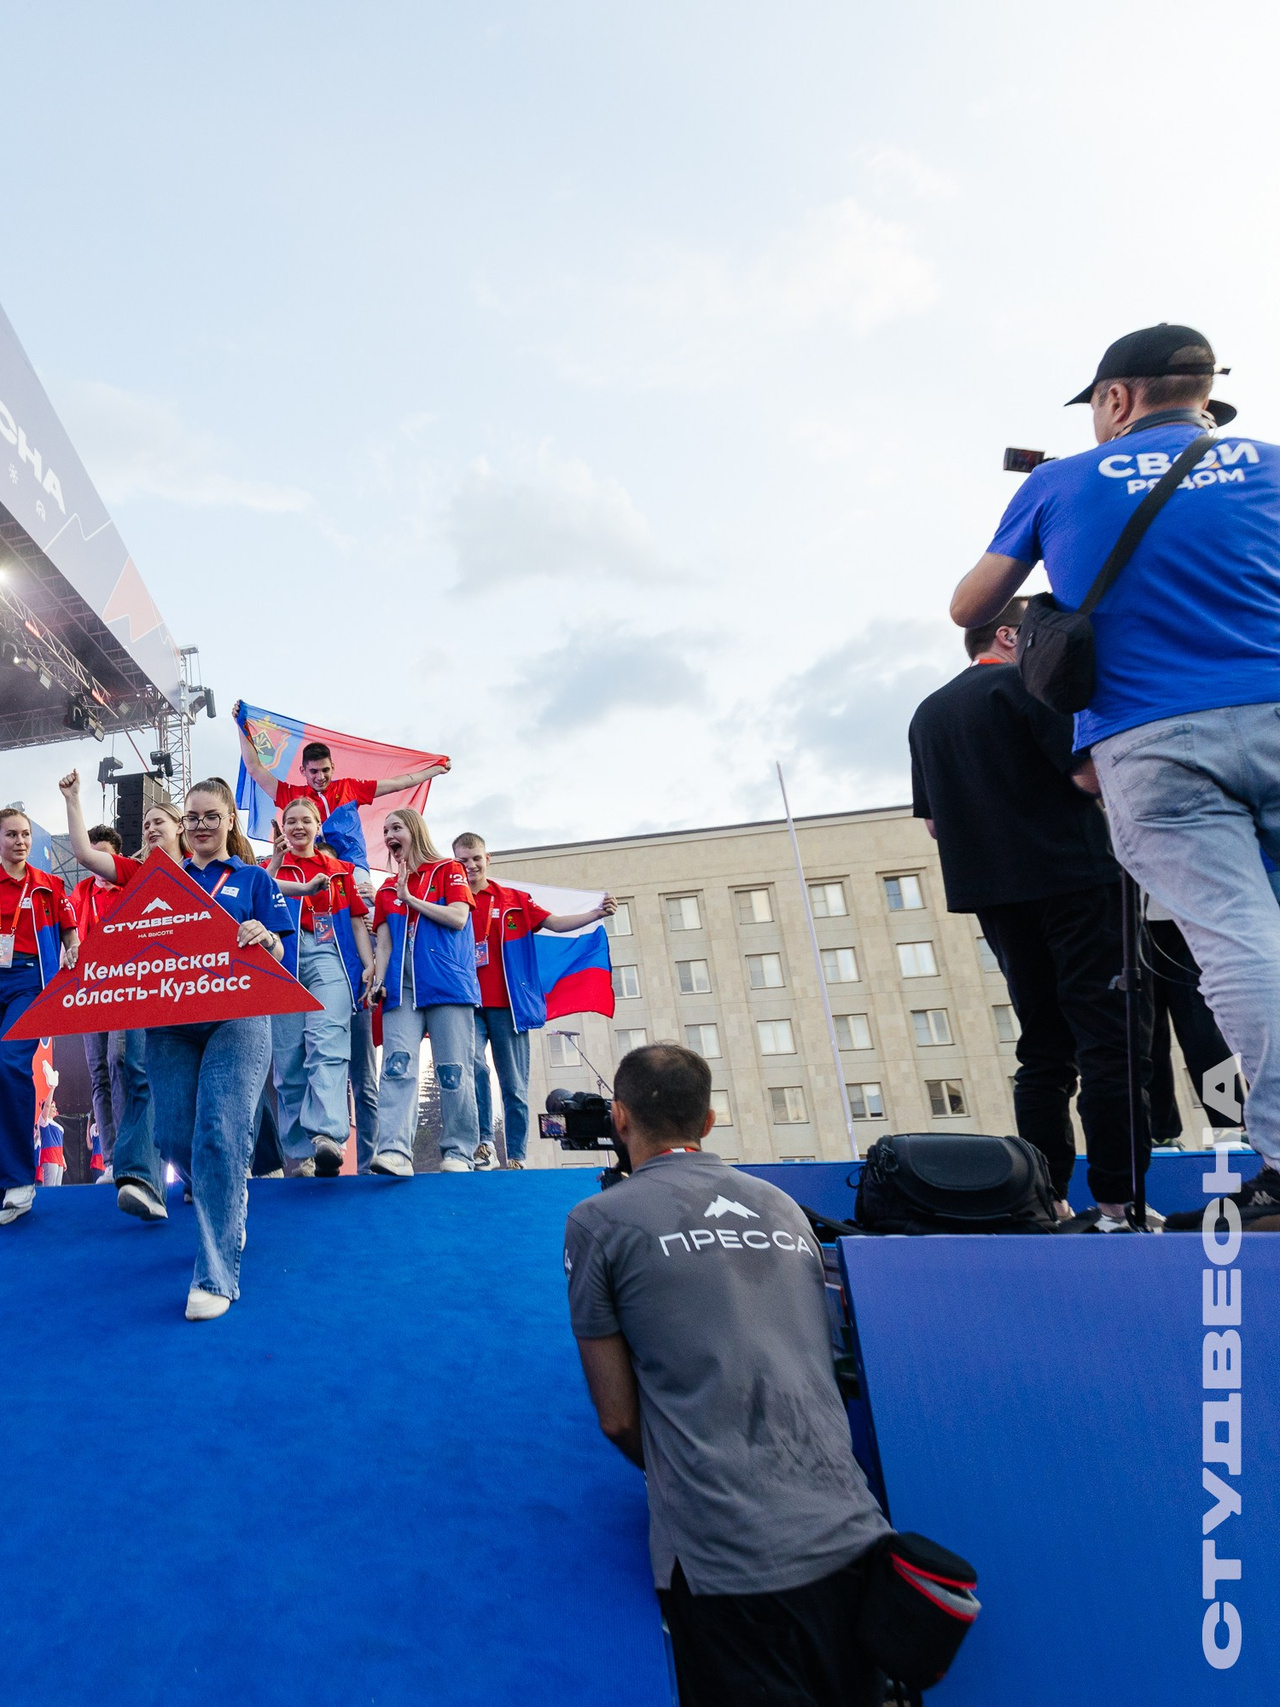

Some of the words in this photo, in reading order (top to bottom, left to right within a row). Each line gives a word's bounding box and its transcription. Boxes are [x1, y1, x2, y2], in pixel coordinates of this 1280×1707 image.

[102, 910, 212, 934] СТУДВЕСНА
[148, 929, 174, 939] ВЫСОТЕ
[83, 951, 230, 982] Кемеровская
[62, 974, 252, 1008] область-Кузбасс
[658, 1229, 814, 1257] ПРЕССА
